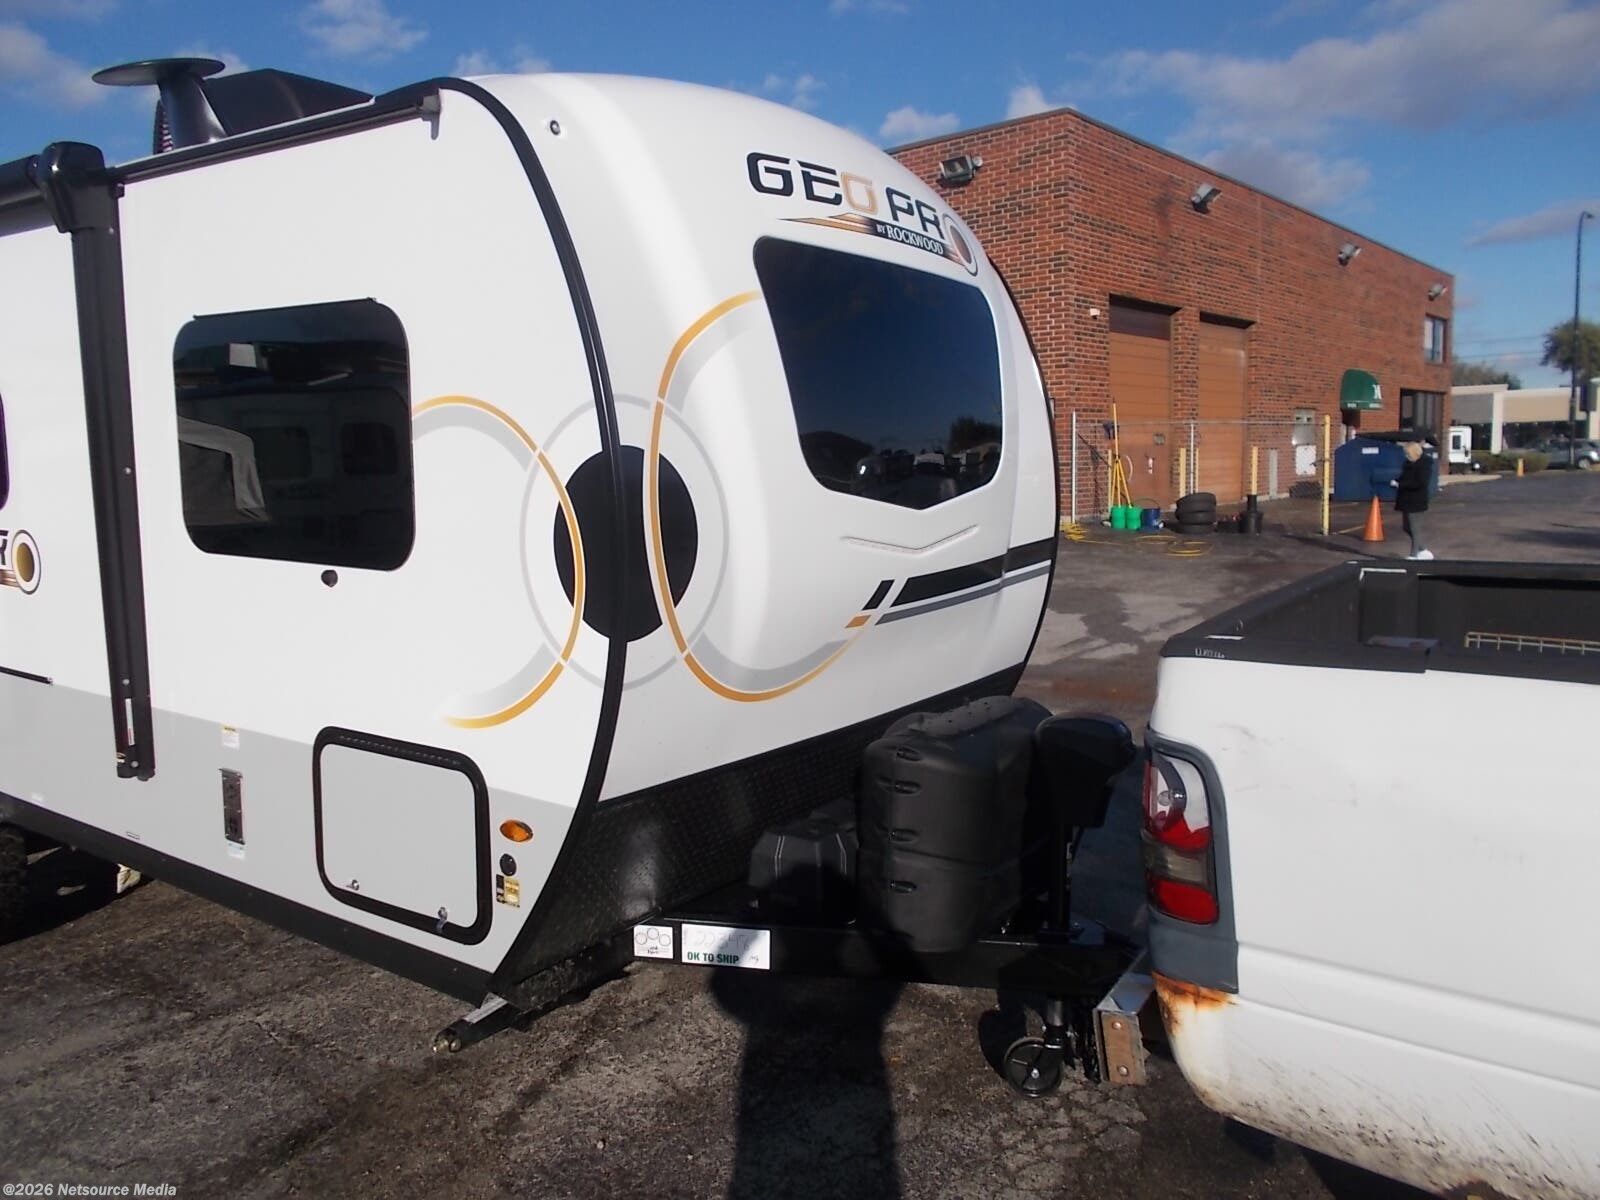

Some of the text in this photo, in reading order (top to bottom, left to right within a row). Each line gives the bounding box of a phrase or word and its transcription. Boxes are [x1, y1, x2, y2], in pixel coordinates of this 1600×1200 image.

[746, 151, 879, 216] GEO
[876, 223, 944, 255] BY ROCKWOOD
[687, 951, 700, 961] OK
[703, 952, 715, 962] TO
[716, 953, 740, 964] SHIP
